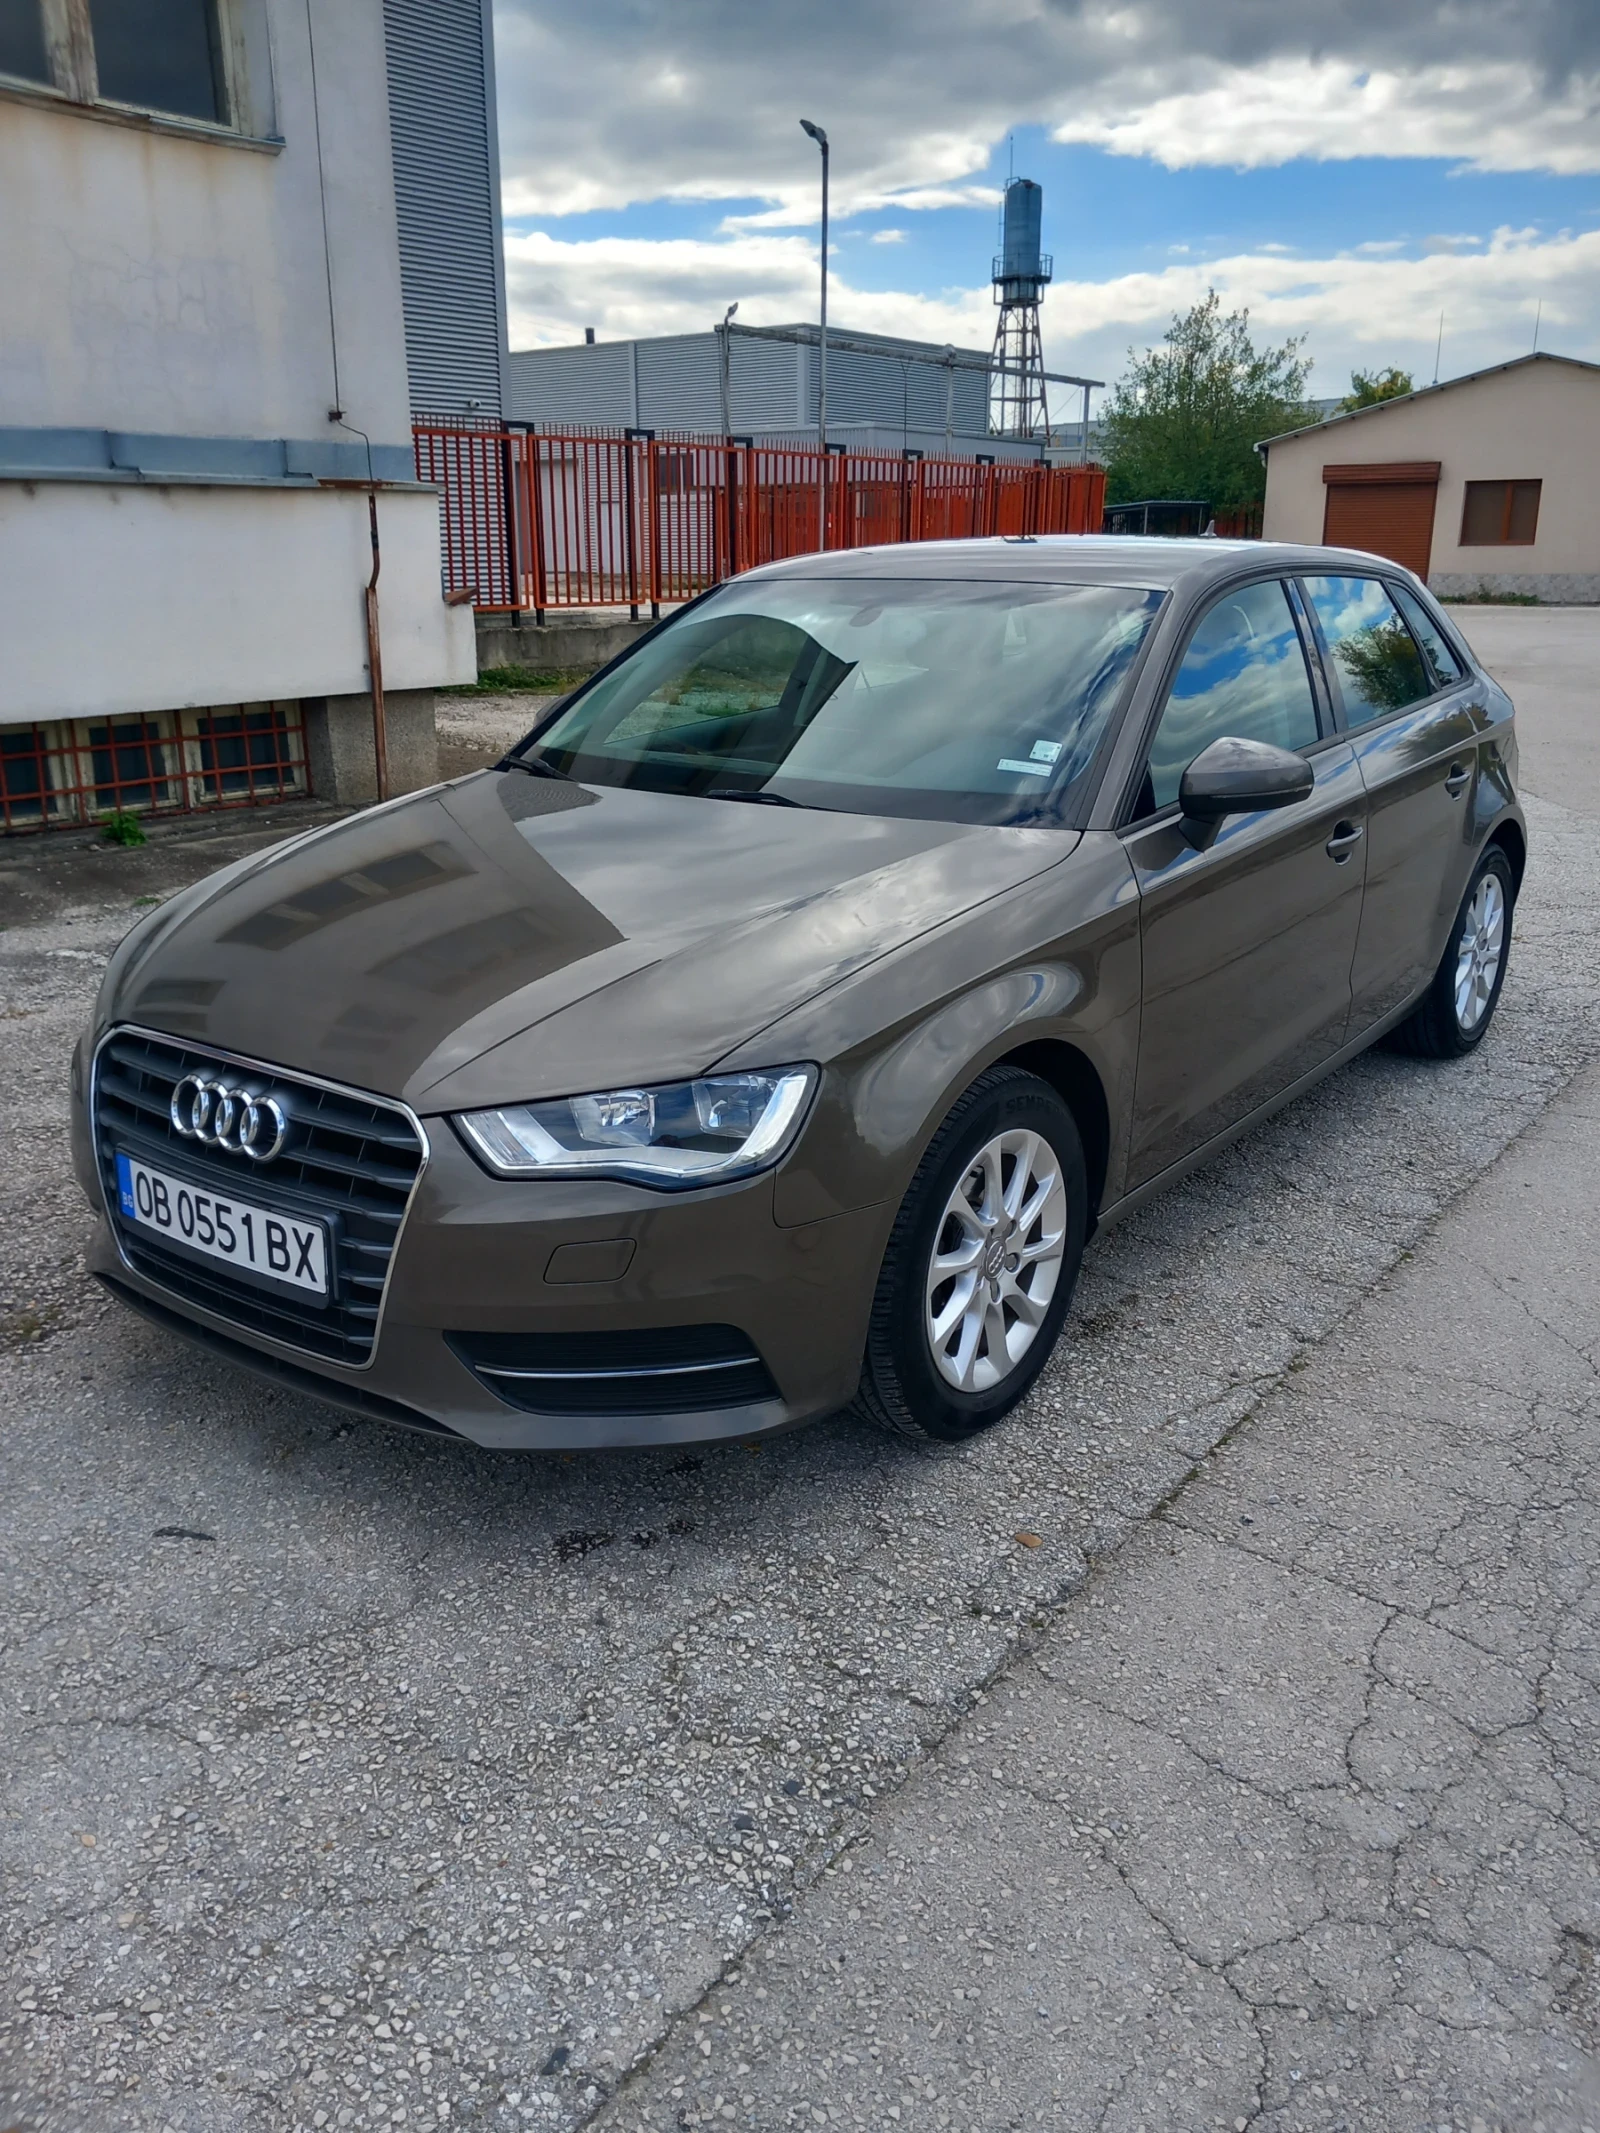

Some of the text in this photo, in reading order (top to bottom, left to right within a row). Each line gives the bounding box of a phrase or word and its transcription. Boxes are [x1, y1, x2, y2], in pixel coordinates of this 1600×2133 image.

[121, 1190, 134, 1209] BG
[136, 1171, 318, 1283] OB 0551 BX
